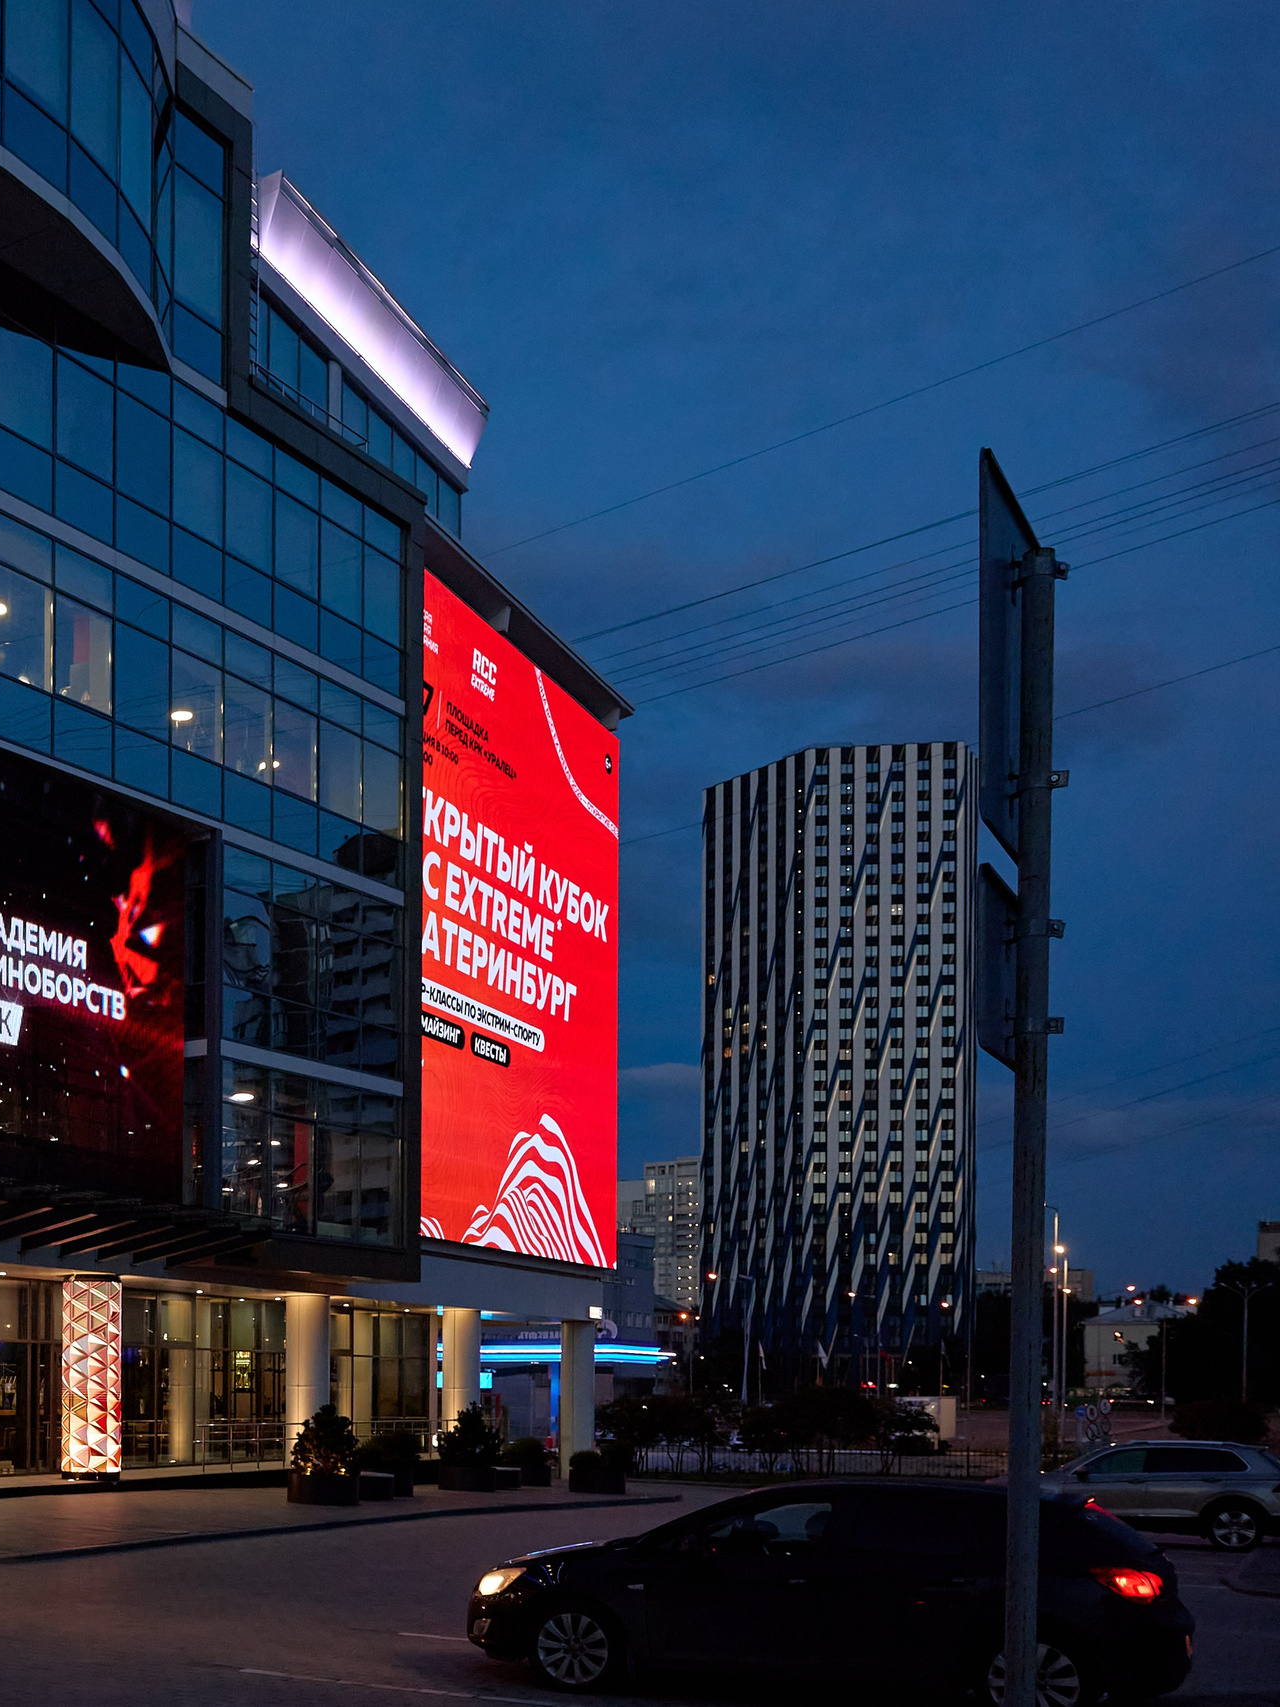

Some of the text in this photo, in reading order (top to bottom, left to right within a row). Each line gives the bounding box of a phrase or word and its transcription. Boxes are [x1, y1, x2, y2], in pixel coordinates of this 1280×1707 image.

[470, 673, 496, 702] EXTREME
[472, 648, 497, 686] RCC
[446, 701, 489, 743] ПЛОЩАДКА
[436, 740, 441, 752] В
[441, 744, 459, 765] 10:00
[445, 719, 517, 780] ПЕРЕД КРК «УРАЛЕЦ»
[538, 862, 609, 943] КУБОК
[421, 911, 577, 1022] АТЕРИНБУРГ
[464, 1001, 476, 1020] ПО
[476, 1007, 541, 1046] ЭКСТРИМ-СПОРТУ
[474, 1037, 507, 1063] КВЕСТЫ
